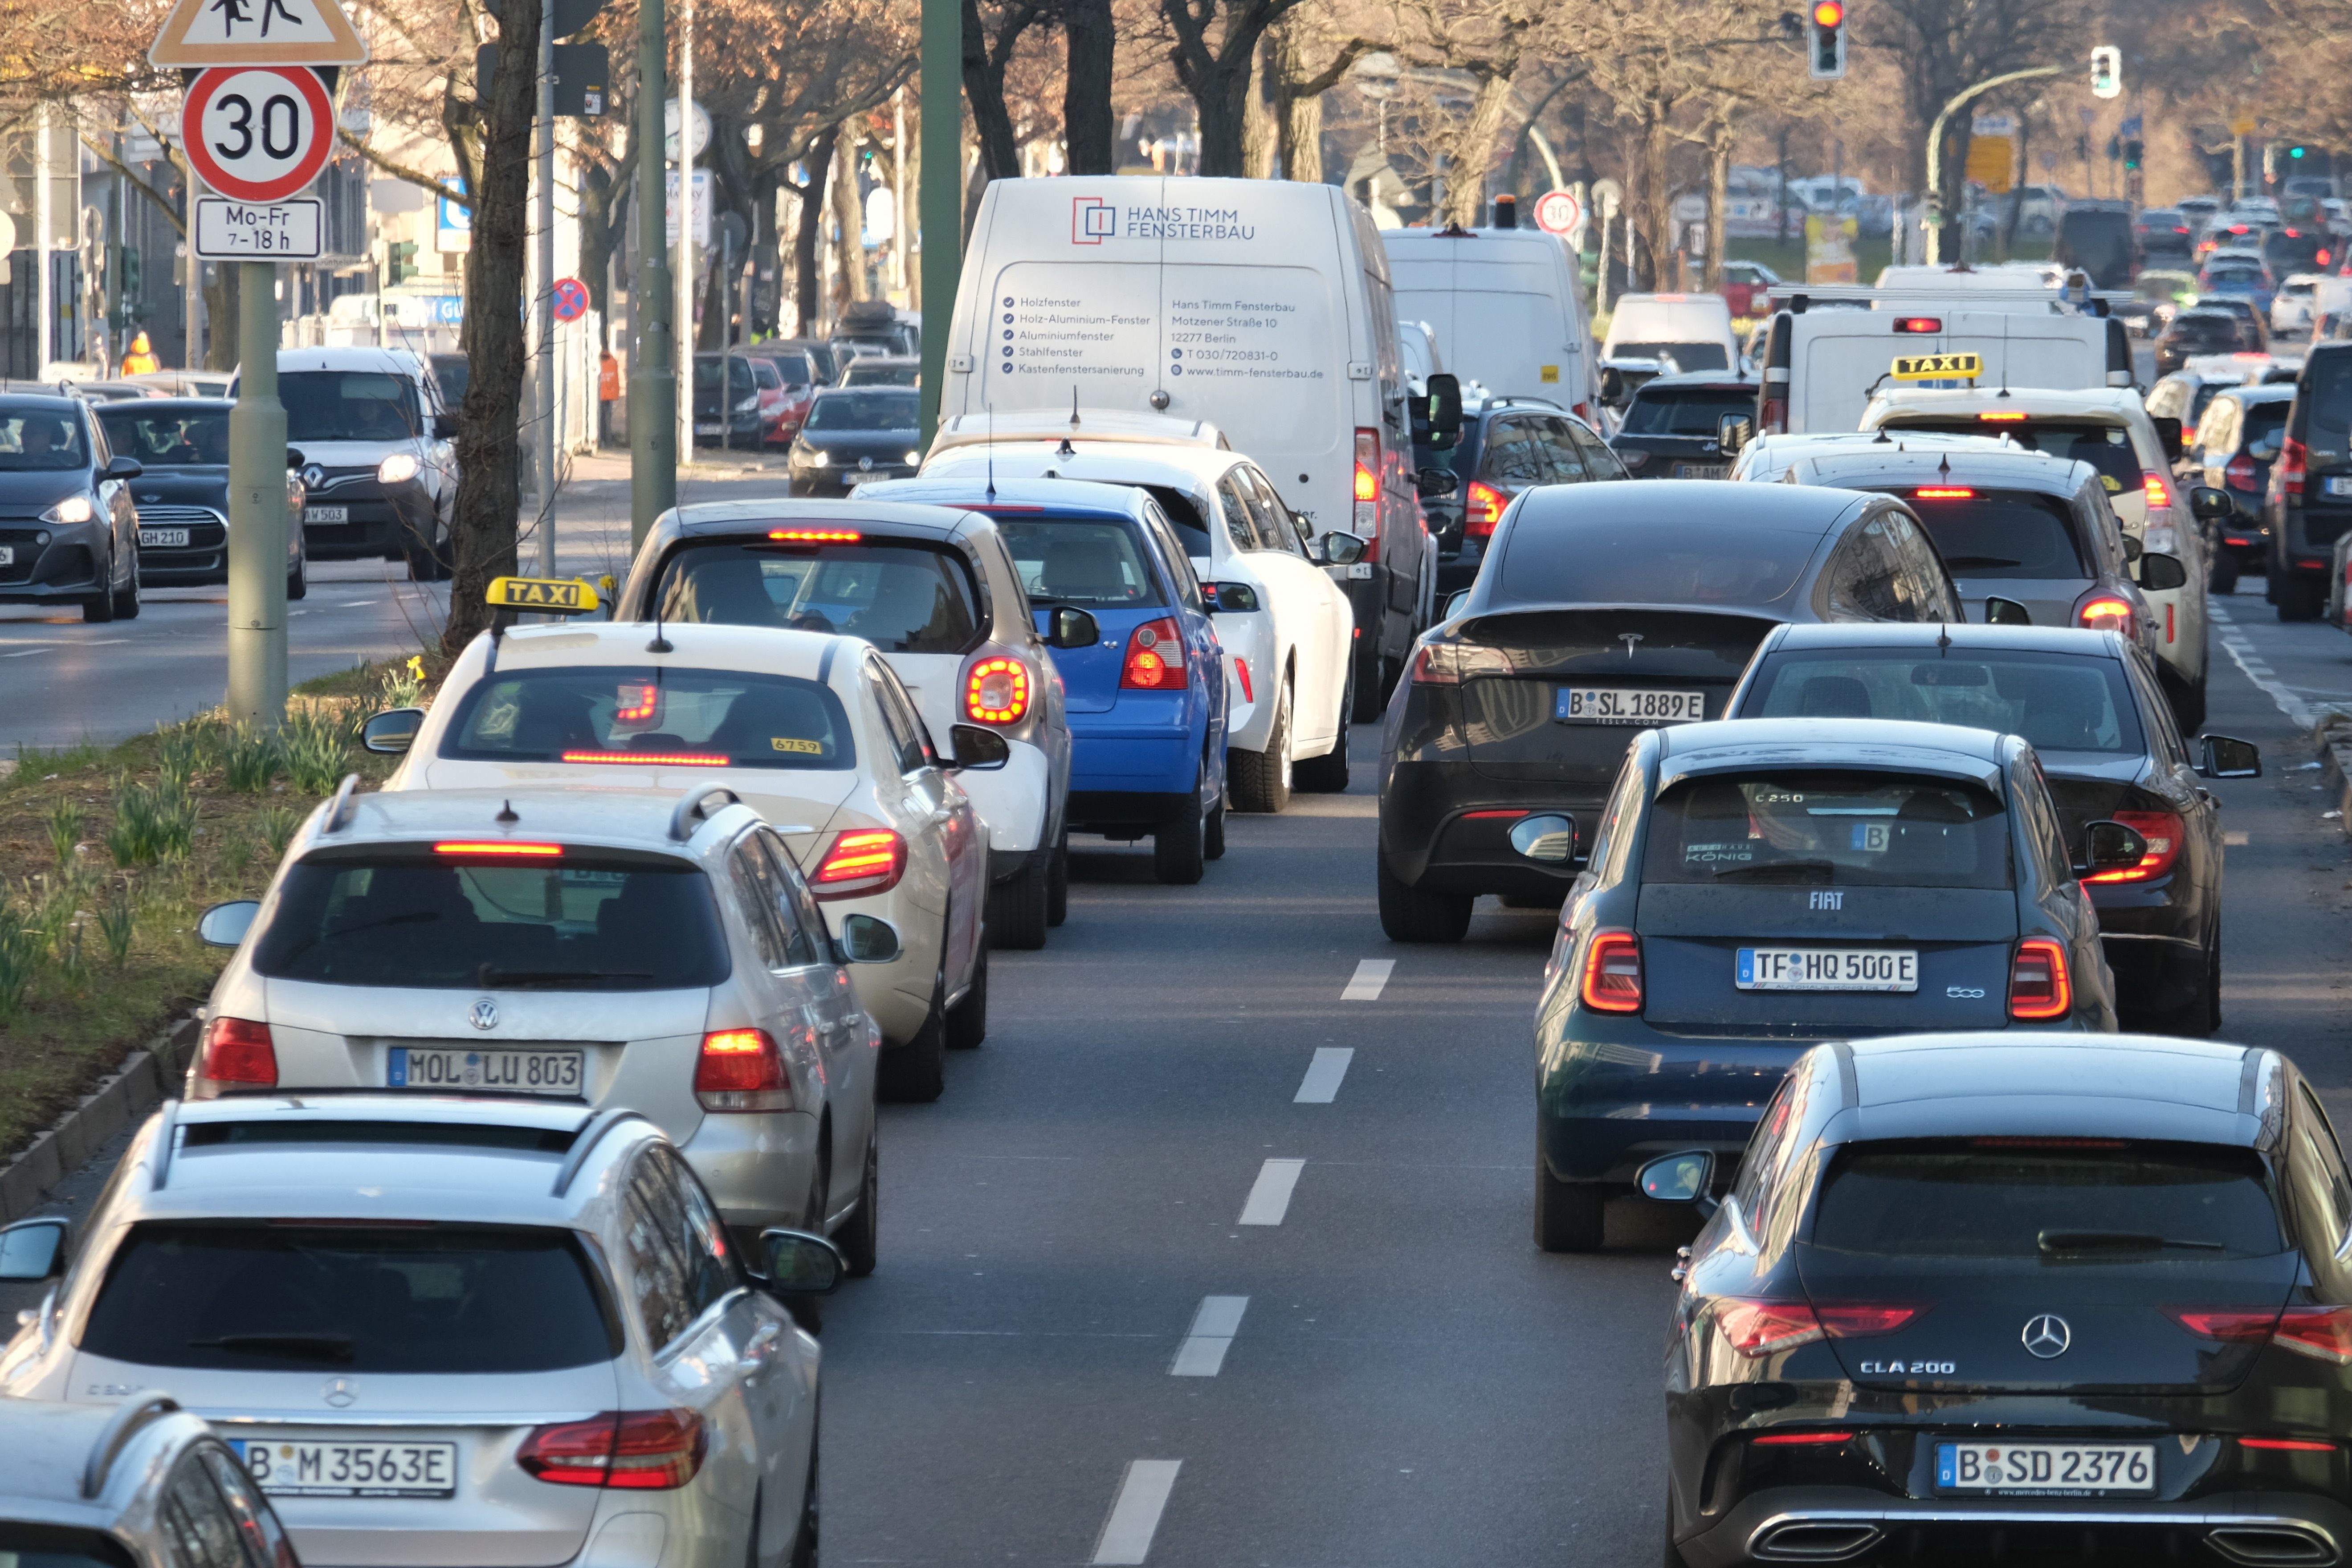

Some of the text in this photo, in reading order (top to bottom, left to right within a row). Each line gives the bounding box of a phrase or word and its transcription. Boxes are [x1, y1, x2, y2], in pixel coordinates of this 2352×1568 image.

[215, 94, 298, 160] 30
[226, 206, 290, 226] Mo-Fr
[1128, 207, 1238, 223] HANS TIMM
[1545, 205, 1568, 223] 30
[1128, 223, 1254, 240] FENSTERBAU
[280, 231, 289, 249] h
[1021, 297, 1081, 307] Holzfenster
[1173, 300, 1296, 312] Hans Timm Fensterbau
[1020, 314, 1151, 325] Holz-Aluminium-Fenster
[1172, 317, 1277, 328] Motzener Straße 10
[1019, 331, 1115, 341] Aluminiumfenster
[1171, 333, 1236, 343] 12277 Berlin
[1019, 347, 1083, 357] Stahlfenster
[1187, 349, 1278, 361] T 030/720831-0
[1019, 364, 1144, 377] Kastenfenstersanierung
[1905, 357, 1967, 373] TAXI
[1187, 368, 1324, 379] www.timm-fensterbau.de
[1684, 468, 1692, 479] B
[321, 509, 342, 521] 503
[142, 532, 184, 543] GH 210
[508, 582, 577, 604] TAXI
[1570, 692, 1582, 715] B
[1598, 692, 1625, 716] SL
[776, 740, 817, 752] 6759
[1768, 794, 1803, 802] 250
[1868, 827, 1883, 845] B
[1685, 852, 1752, 863] KÖNIG
[1809, 892, 1844, 910] FIAT
[1757, 954, 1788, 979] TF
[1806, 955, 1838, 980] HQ
[410, 1054, 461, 1084] MOL
[484, 1055, 519, 1084] LU
[527, 1056, 577, 1086] 803
[1861, 1360, 1956, 1374] CLA 200
[250, 1447, 270, 1480] B
[299, 1448, 322, 1482] M
[1960, 1450, 1980, 1482] B
[2007, 1450, 2051, 1482] SD
[2061, 1451, 2148, 1483] 2376
